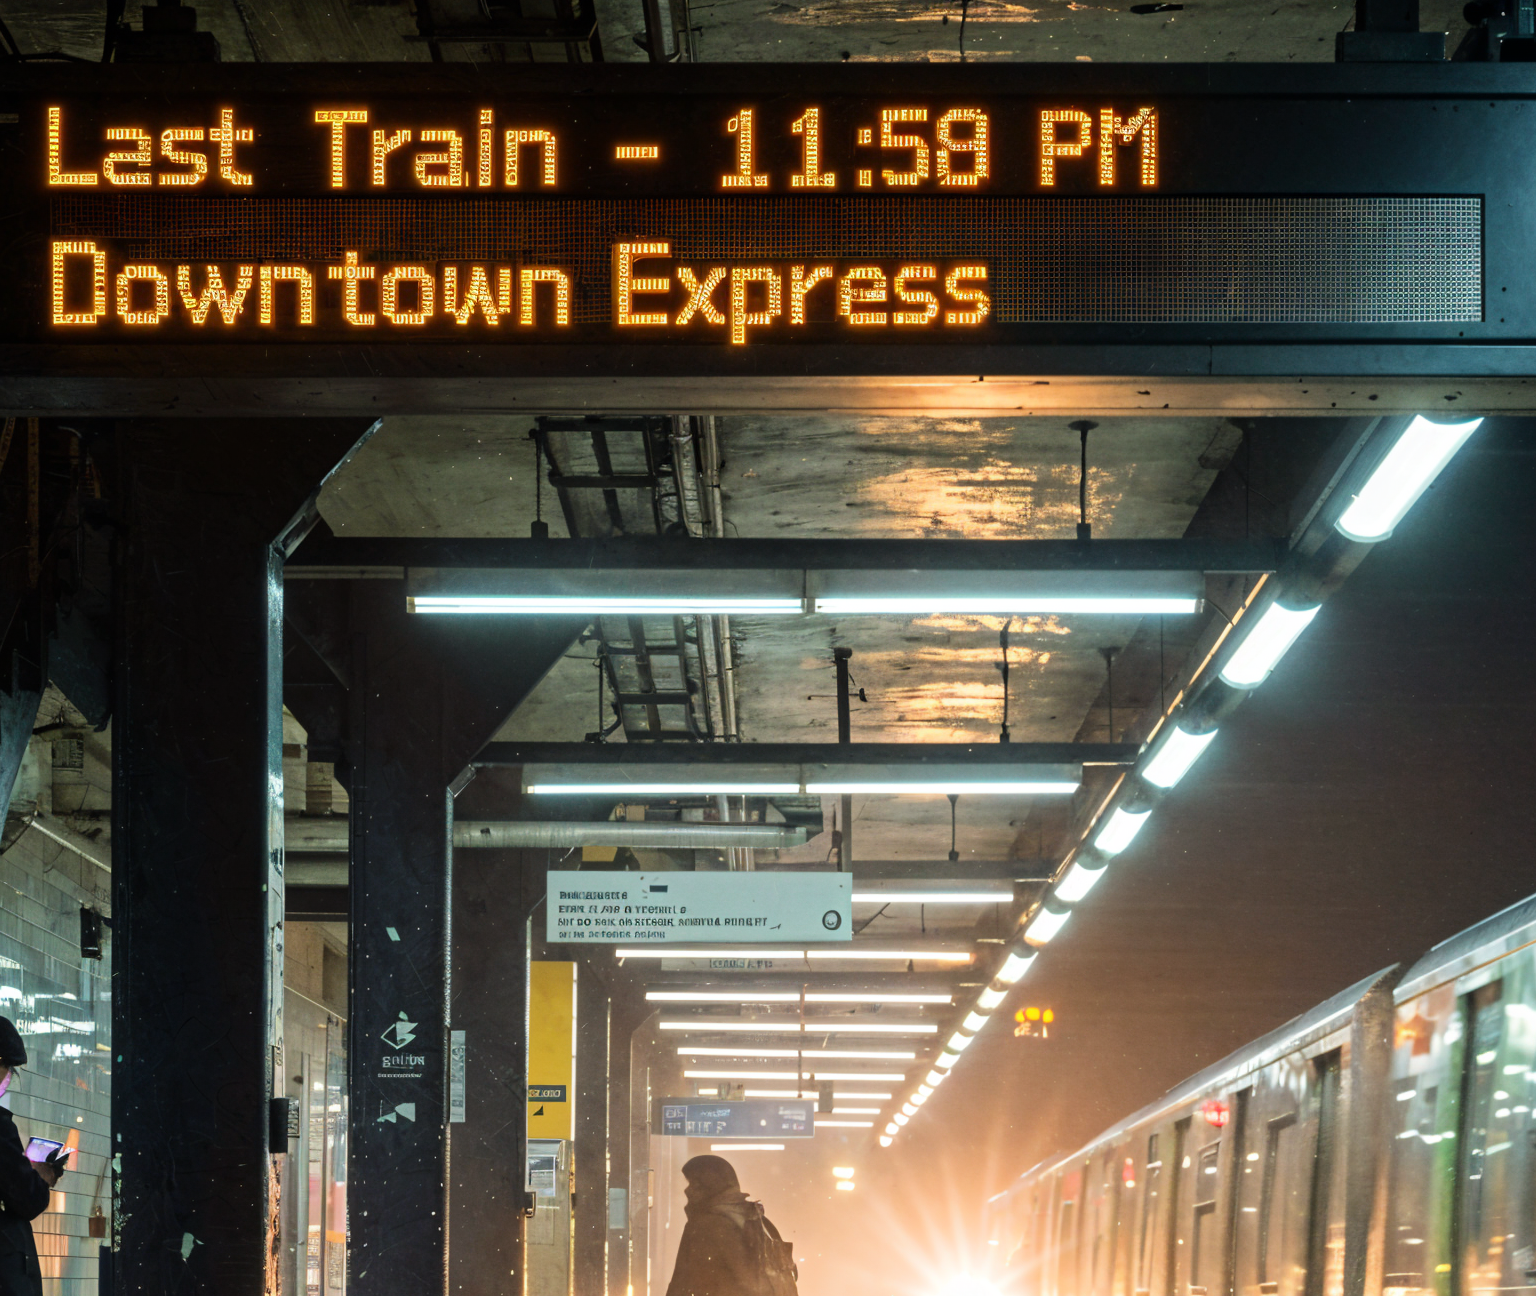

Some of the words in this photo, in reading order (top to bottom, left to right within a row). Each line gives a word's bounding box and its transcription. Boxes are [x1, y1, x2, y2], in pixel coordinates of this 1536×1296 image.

[46, 106, 255, 188] Last
[313, 107, 559, 189] Train
[614, 144, 661, 161] -
[720, 106, 992, 189] 11:58
[1038, 107, 1160, 188] PM
[50, 239, 572, 328] Downtown
[610, 235, 992, 346] Express
